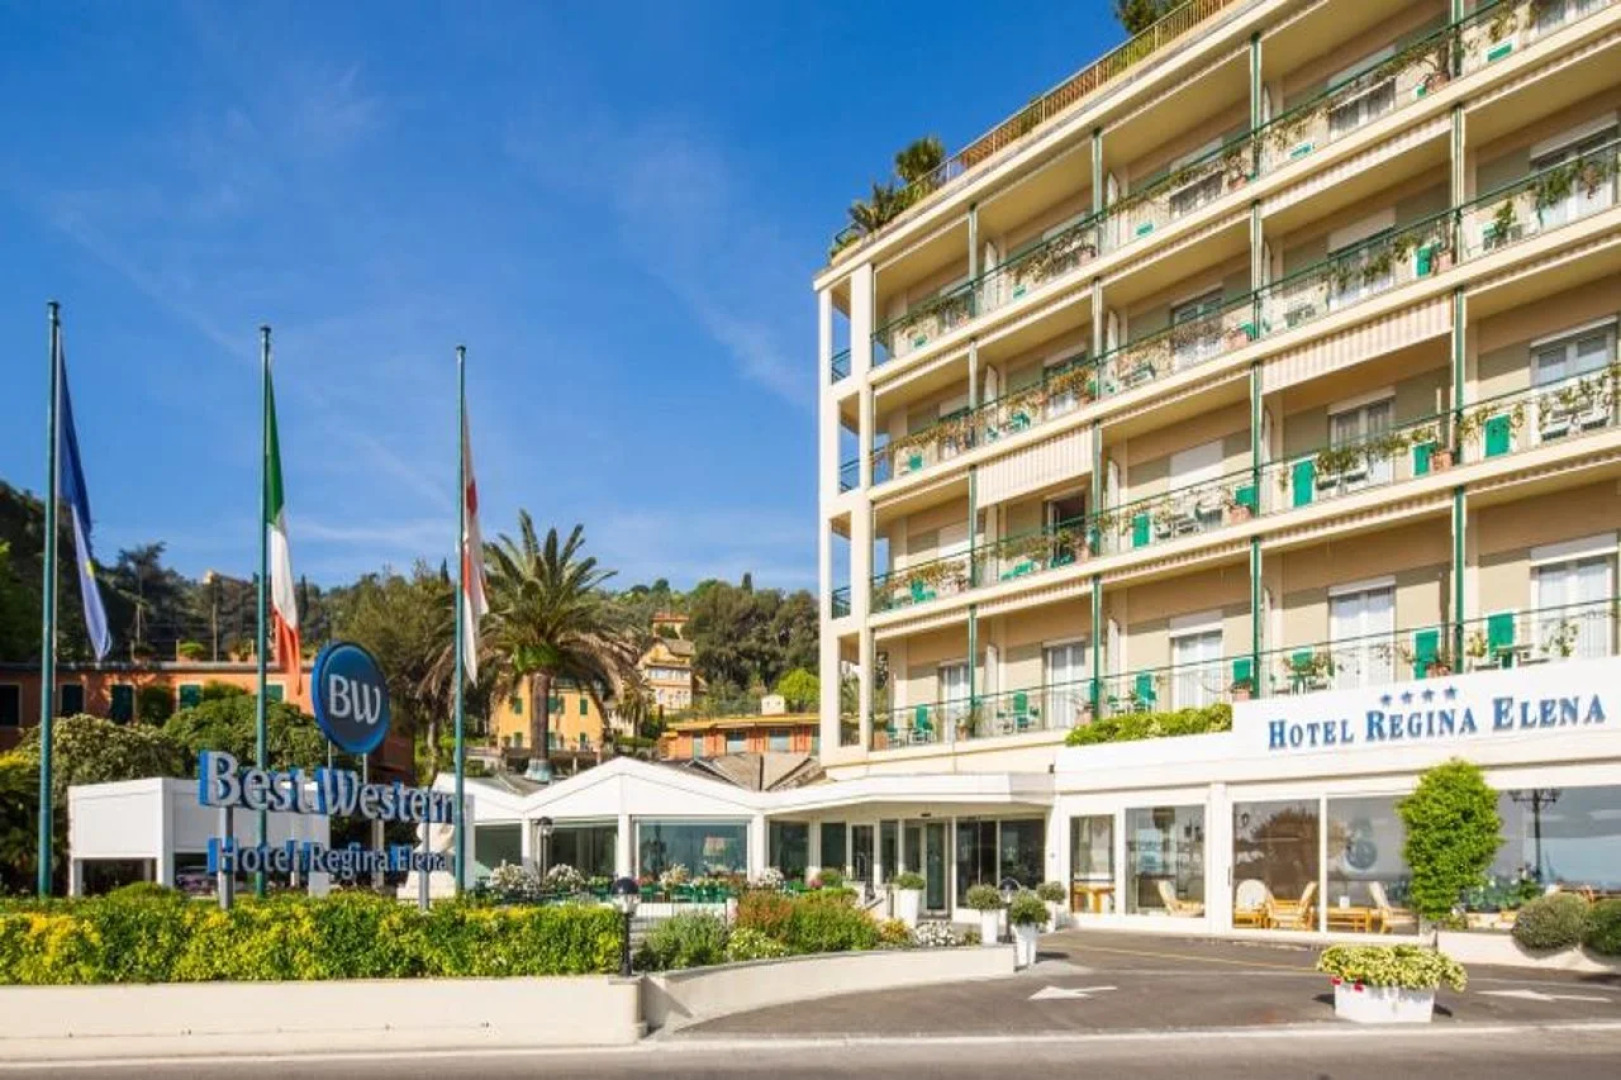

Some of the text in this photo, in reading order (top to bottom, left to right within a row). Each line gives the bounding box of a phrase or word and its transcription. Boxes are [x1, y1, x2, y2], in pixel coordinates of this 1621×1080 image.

[329, 674, 381, 724] BW
[1268, 694, 1606, 749] HOTEL REGINA ELENA
[201, 751, 459, 823] Best Western
[211, 837, 447, 880] Hotel Regina Elena
